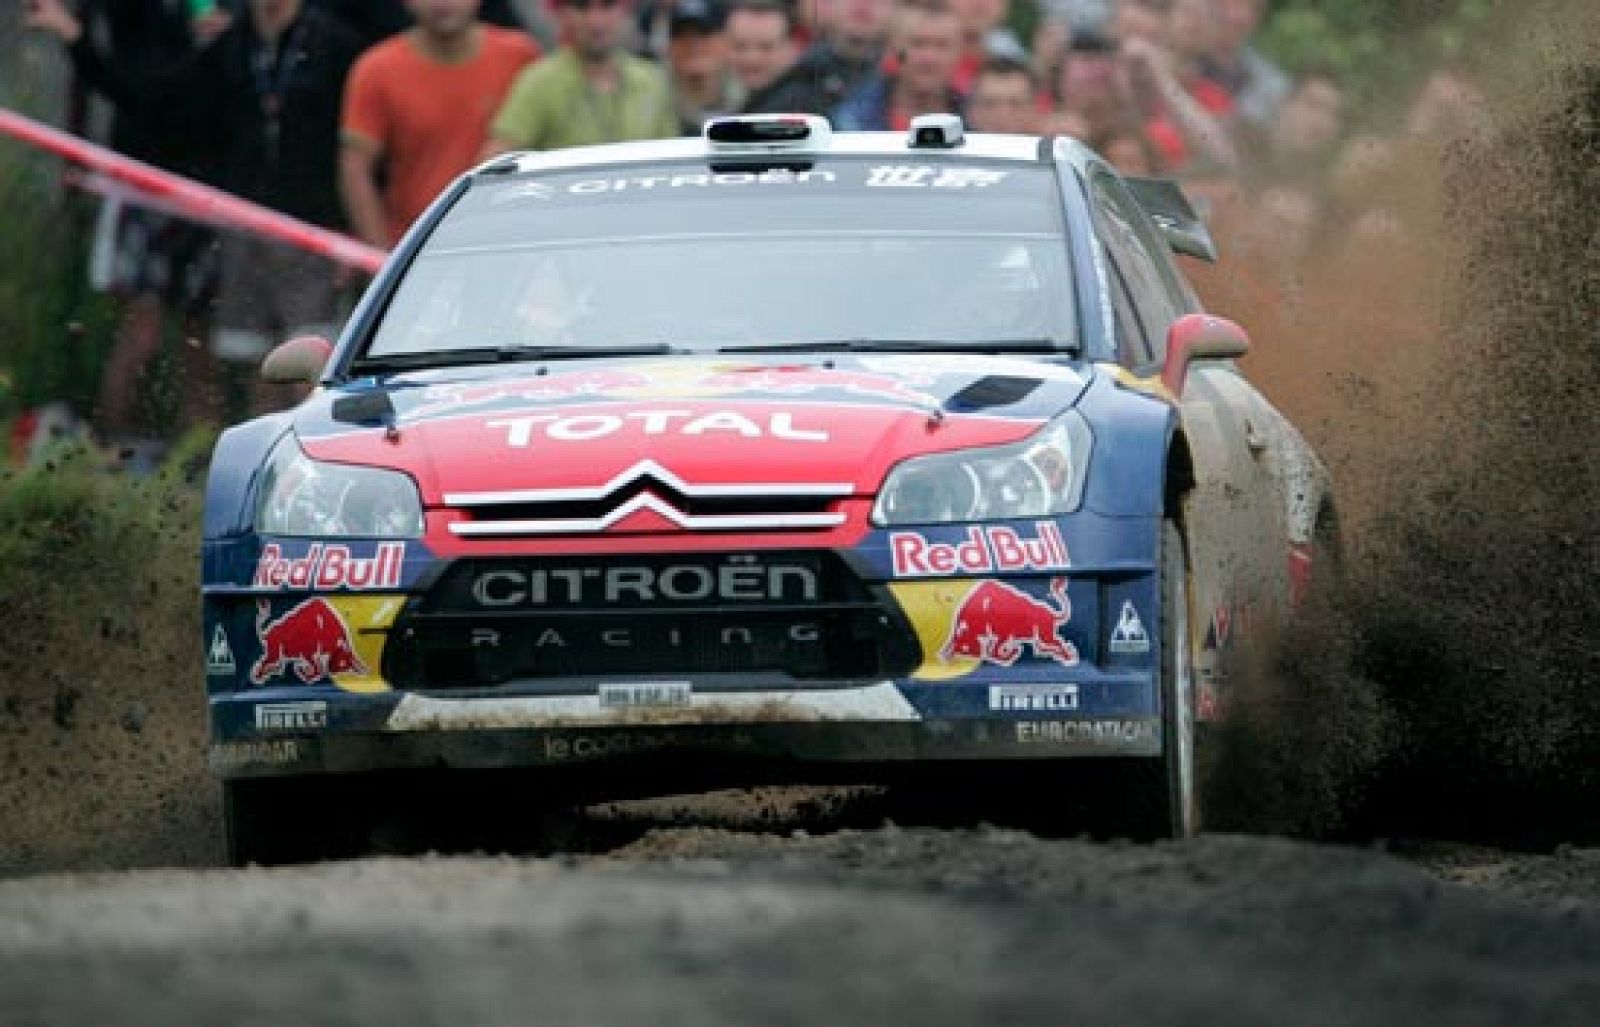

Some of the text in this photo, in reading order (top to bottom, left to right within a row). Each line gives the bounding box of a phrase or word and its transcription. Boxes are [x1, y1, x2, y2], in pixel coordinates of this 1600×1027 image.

[486, 409, 830, 447] TOTAL
[255, 541, 405, 588] Red Bull
[891, 520, 1072, 576] Red Bull
